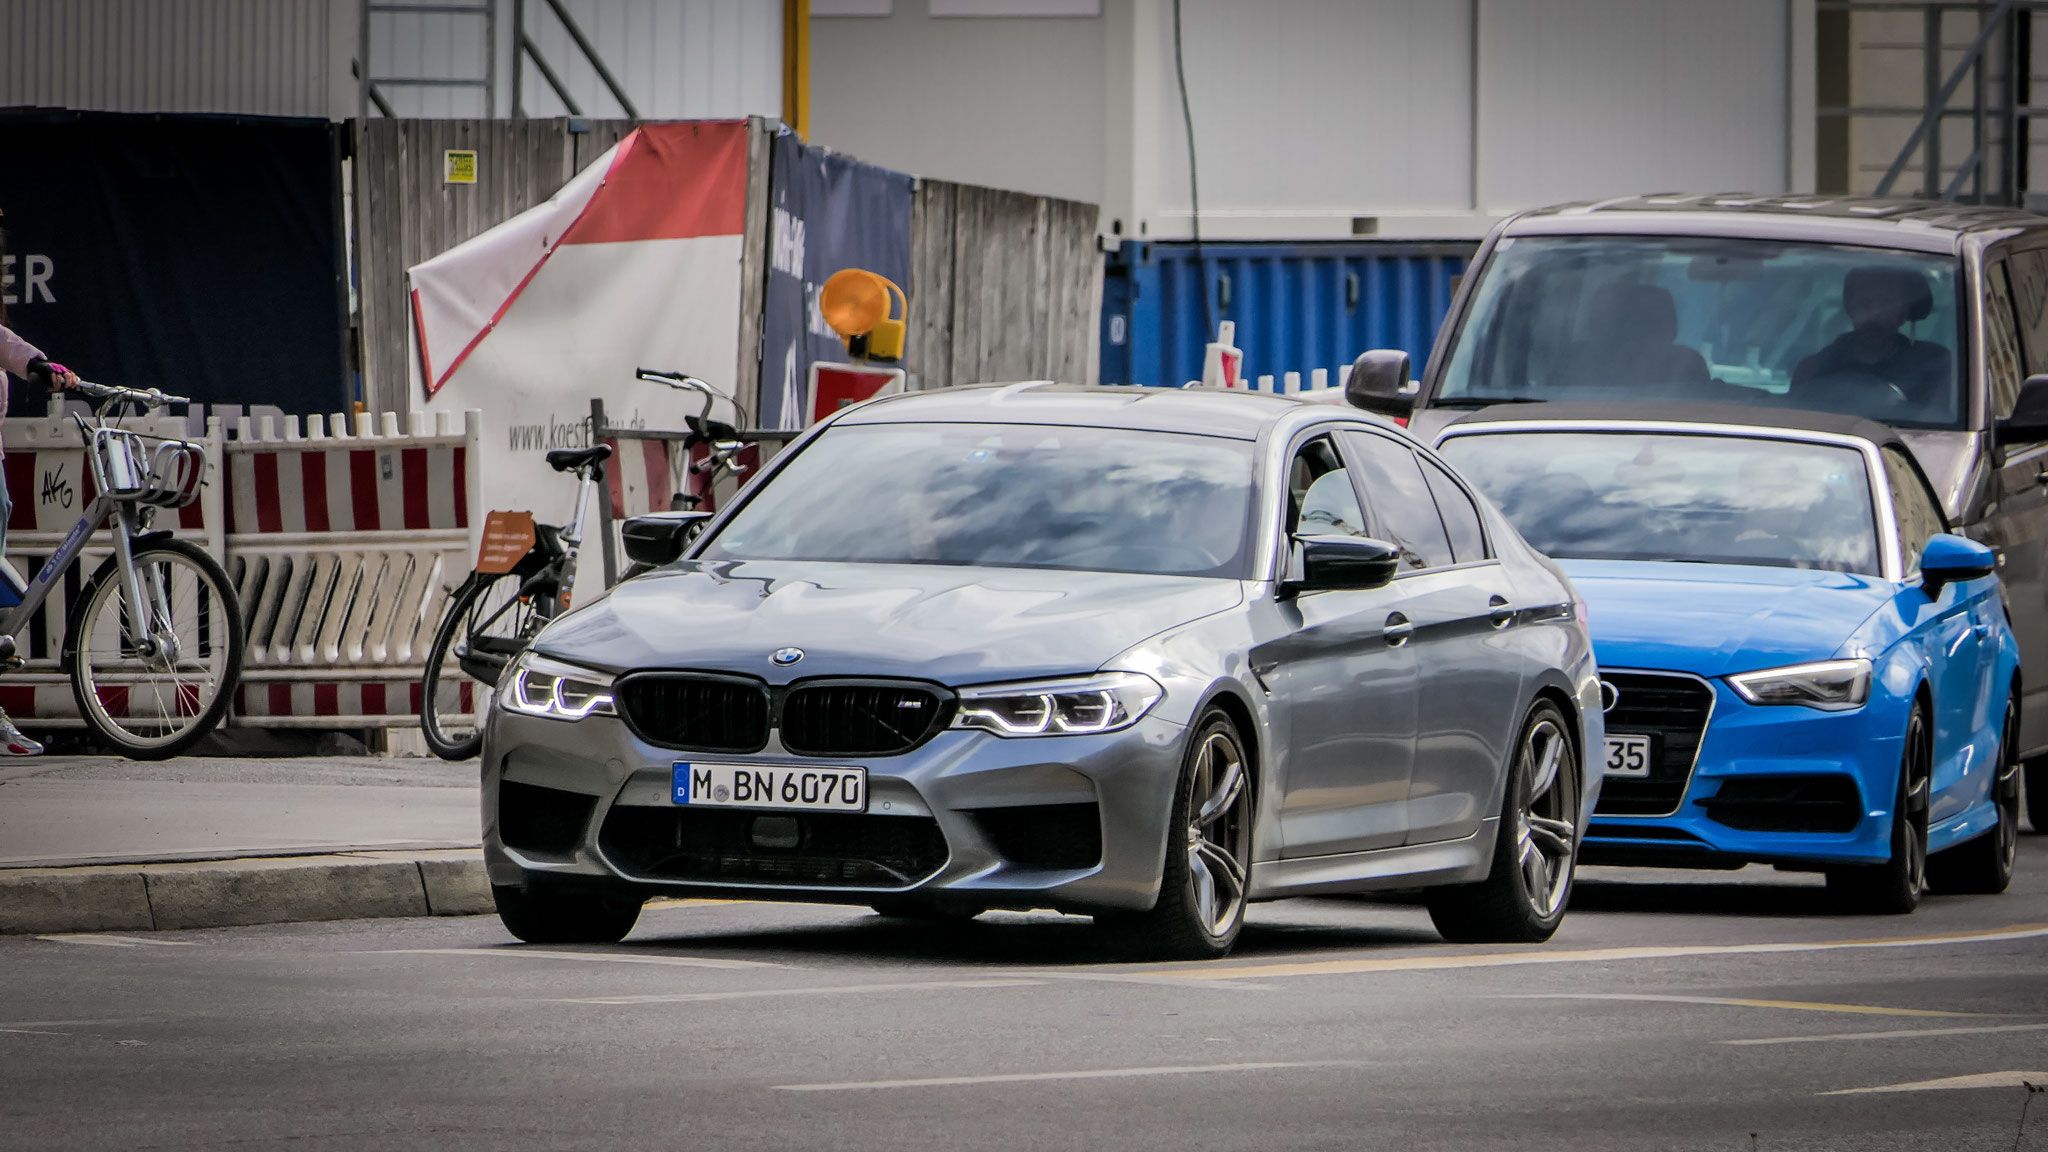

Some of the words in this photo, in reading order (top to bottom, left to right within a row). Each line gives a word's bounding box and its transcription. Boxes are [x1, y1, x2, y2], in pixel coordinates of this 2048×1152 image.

[1603, 741, 1645, 770] 35
[677, 786, 685, 797] D
[693, 769, 712, 799] M
[733, 771, 774, 801] BN
[781, 772, 859, 804] 6070
